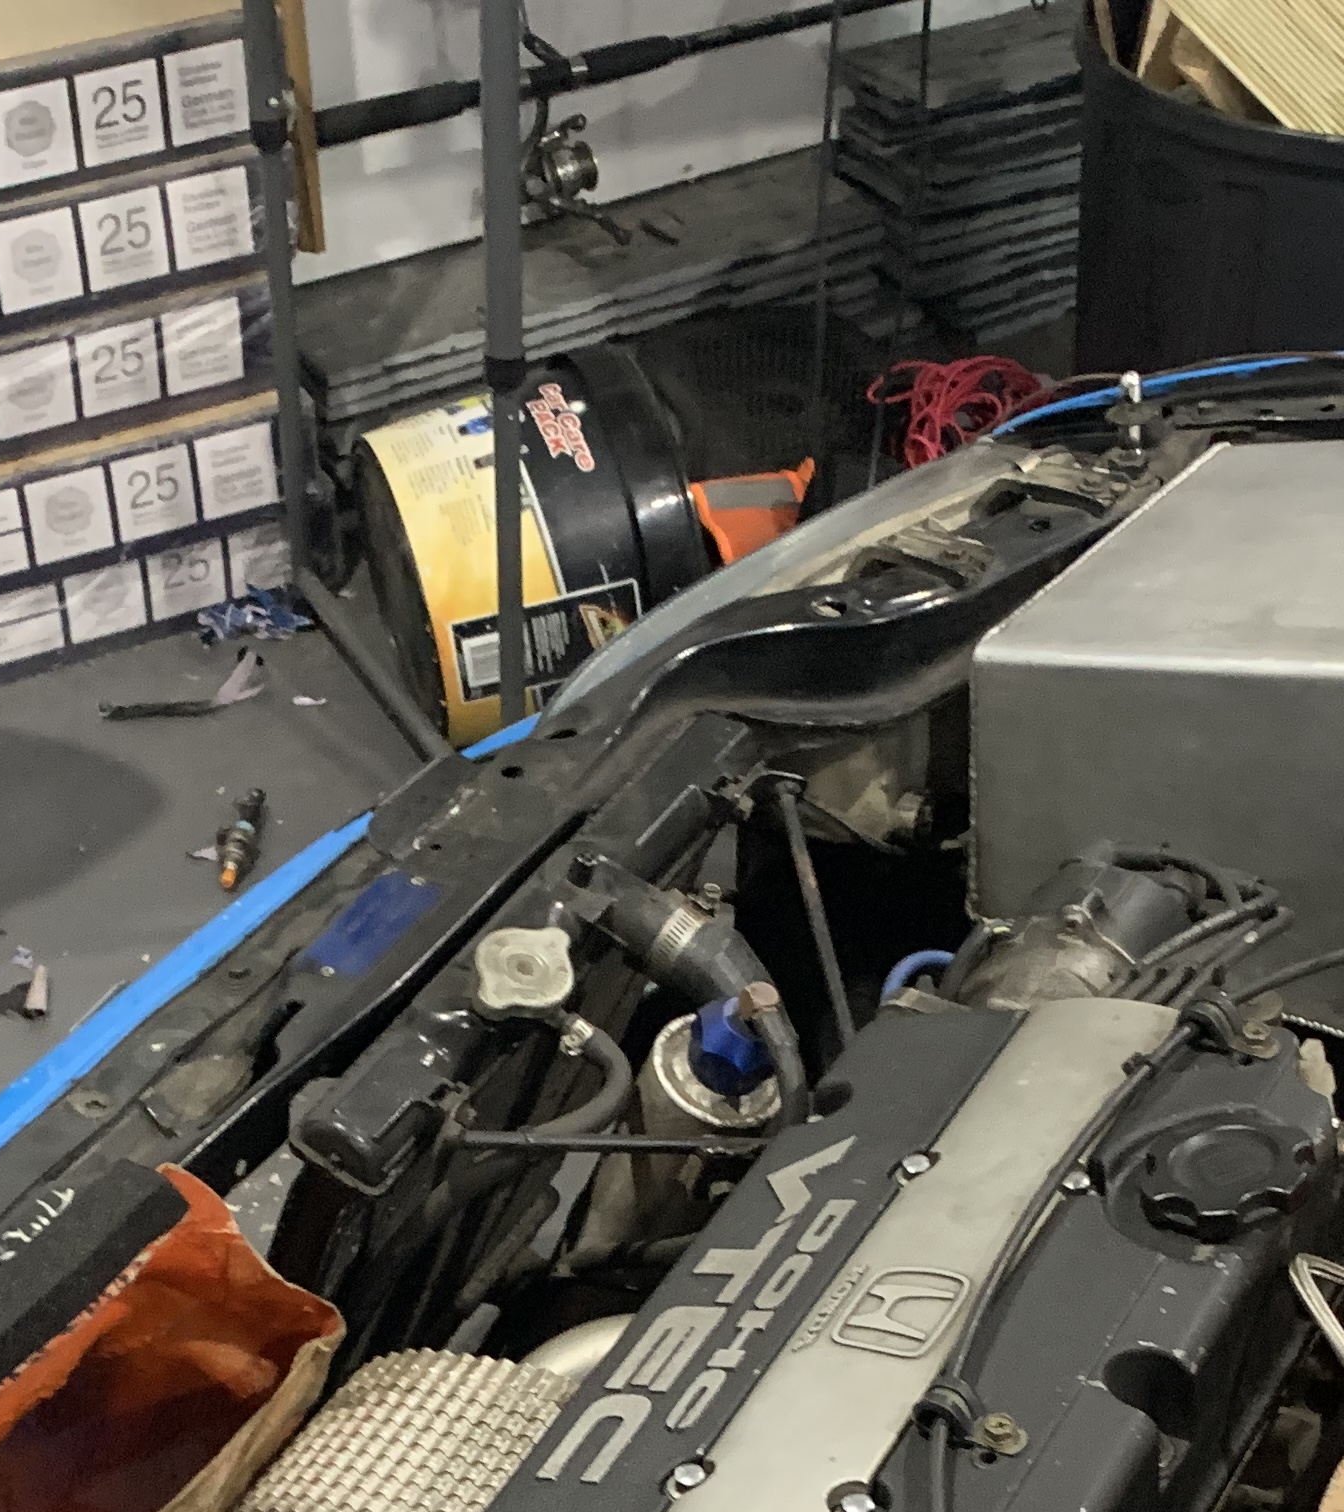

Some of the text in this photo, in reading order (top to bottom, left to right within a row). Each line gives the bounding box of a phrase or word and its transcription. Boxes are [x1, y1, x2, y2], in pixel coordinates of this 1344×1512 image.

[91, 79, 147, 130] 25
[97, 205, 151, 256] 25
[91, 336, 145, 385] 25
[126, 462, 180, 510] 25
[536, 1135, 856, 1484] VTEC
[665, 1199, 858, 1432] DOHC
[792, 1263, 868, 1354] HONDA
